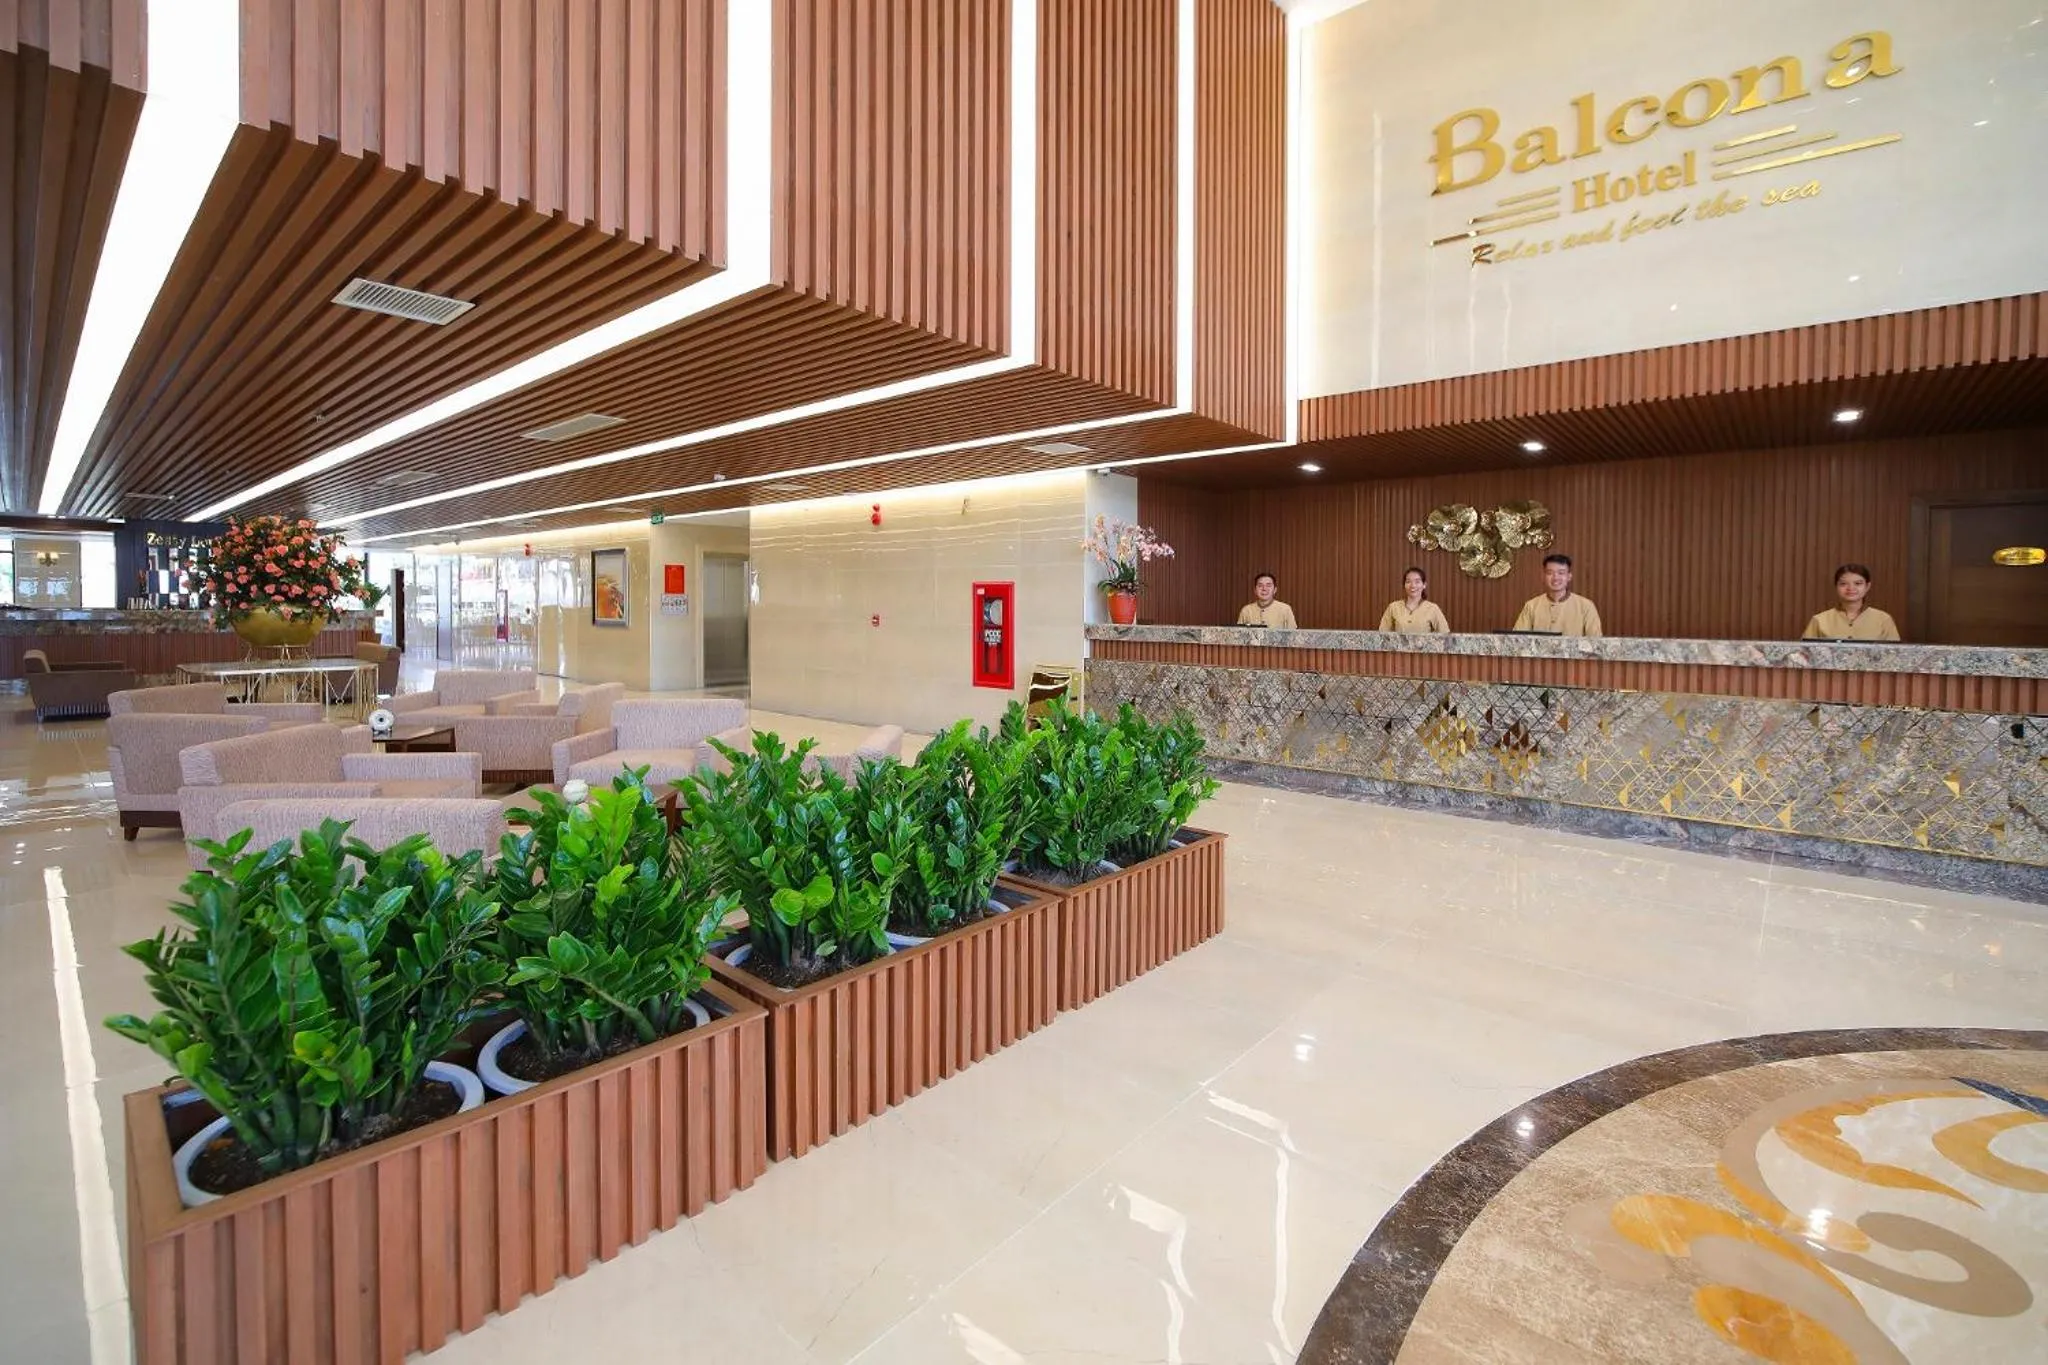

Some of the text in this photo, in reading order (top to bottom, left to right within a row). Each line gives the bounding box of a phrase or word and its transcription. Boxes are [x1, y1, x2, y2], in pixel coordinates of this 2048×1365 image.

[1430, 28, 1905, 197] Balcona
[1560, 219, 1616, 250] and
[1619, 203, 1690, 242] feel
[1694, 189, 1750, 221] the
[1760, 179, 1823, 207] sea
[1572, 150, 1698, 214] Hotel
